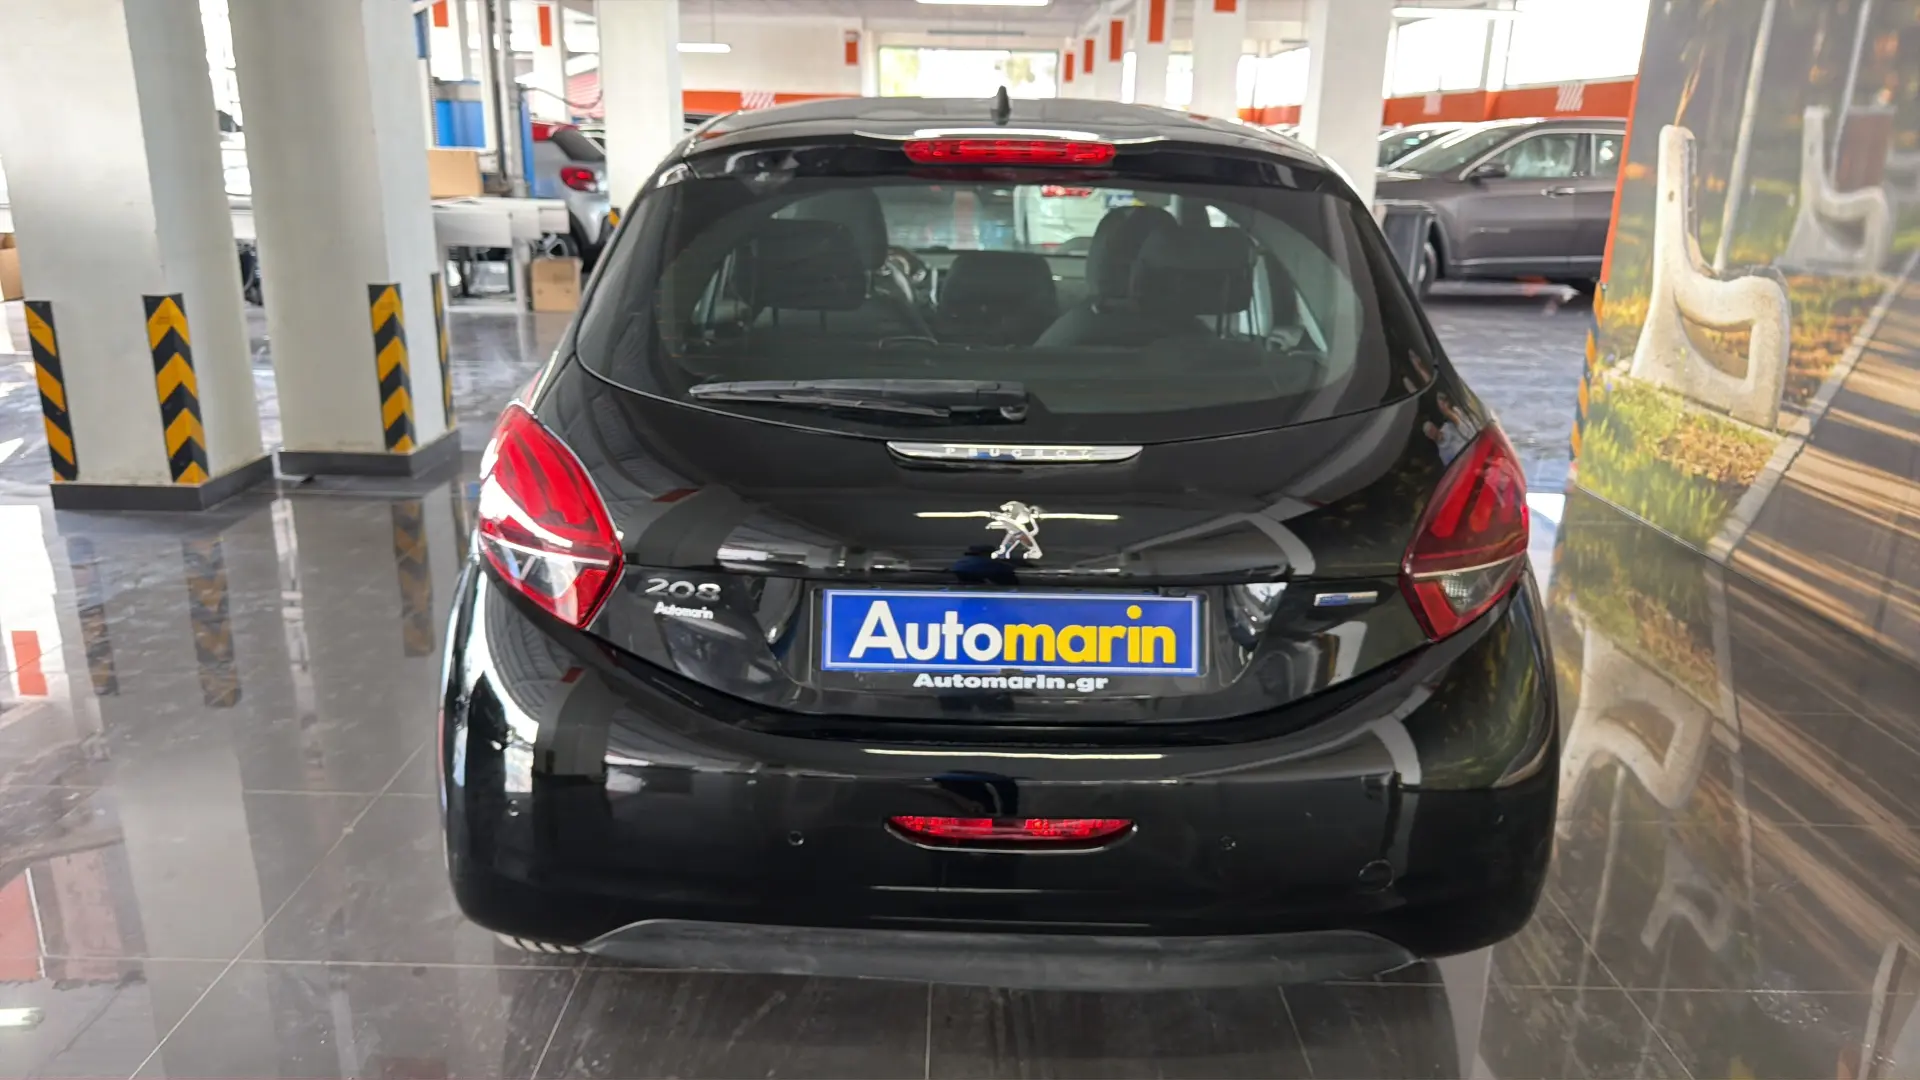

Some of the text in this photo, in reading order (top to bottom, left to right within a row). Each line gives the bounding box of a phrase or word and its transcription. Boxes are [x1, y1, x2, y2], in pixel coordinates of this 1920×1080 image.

[645, 578, 721, 601] 208
[848, 600, 1176, 664] Automarin
[912, 674, 1109, 692] Automarin.gr
